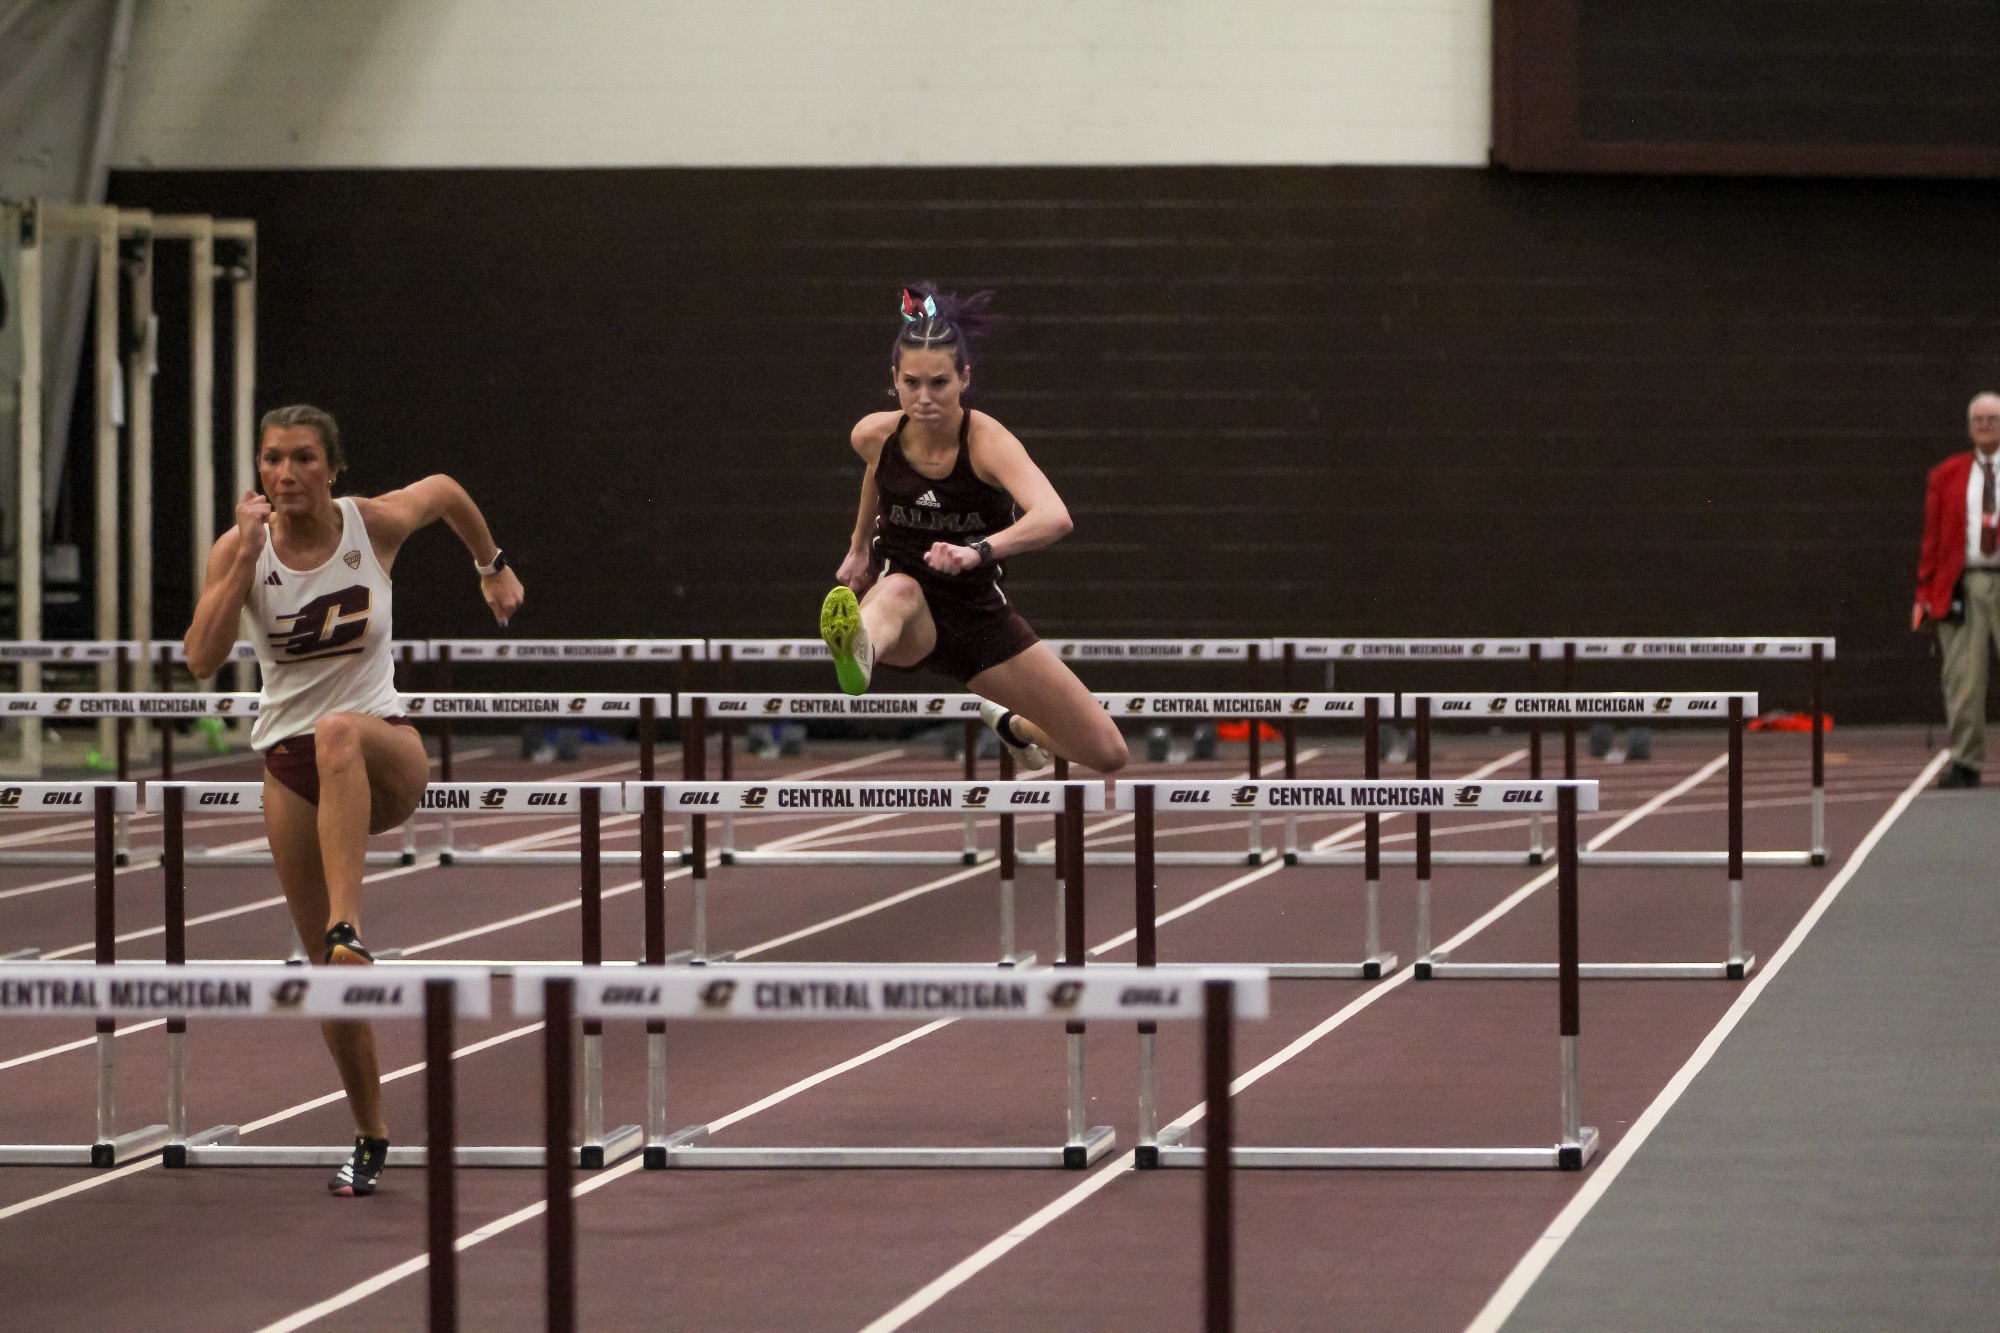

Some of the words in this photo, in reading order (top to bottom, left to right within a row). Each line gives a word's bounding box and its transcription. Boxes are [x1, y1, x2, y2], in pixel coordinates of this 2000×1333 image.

[916, 499, 941, 507] adidas
[889, 504, 987, 531] ALMA
[80, 699, 134, 712] CENTRAL
[140, 699, 206, 712] MICHIGAN
[433, 699, 488, 712] CENTRAL
[493, 699, 559, 712] MICHIGAN
[718, 701, 747, 711] GILL
[790, 700, 845, 713] CENTRAL
[851, 700, 917, 713] MICHIGAN
[1153, 699, 1209, 712] CENTRAL
[1214, 699, 1281, 712] MICHIGAN
[1325, 701, 1354, 711] GILL
[1442, 700, 1472, 711] GILL
[1515, 699, 1571, 712] CENTRAL
[1575, 699, 1644, 712] MICHIGAN
[1687, 700, 1718, 710] GILL
[42, 792, 83, 805] GILL
[200, 792, 240, 805] GILL
[527, 792, 568, 806] GILL
[679, 791, 720, 805] GILL
[778, 788, 854, 807] CENTRAL
[859, 788, 952, 807] MICHIGAN
[1009, 791, 1051, 804] GILL
[1169, 790, 1210, 803] GILL
[1269, 787, 1345, 806] CENTRAL
[1351, 787, 1444, 806] MICHIGAN
[1502, 790, 1544, 803] GILL
[0, 979, 97, 1007] ENTRAL
[110, 979, 252, 1008] MICHIGAN
[755, 981, 869, 1009] CENTRAL
[883, 981, 1026, 1009] MICHIGAN
